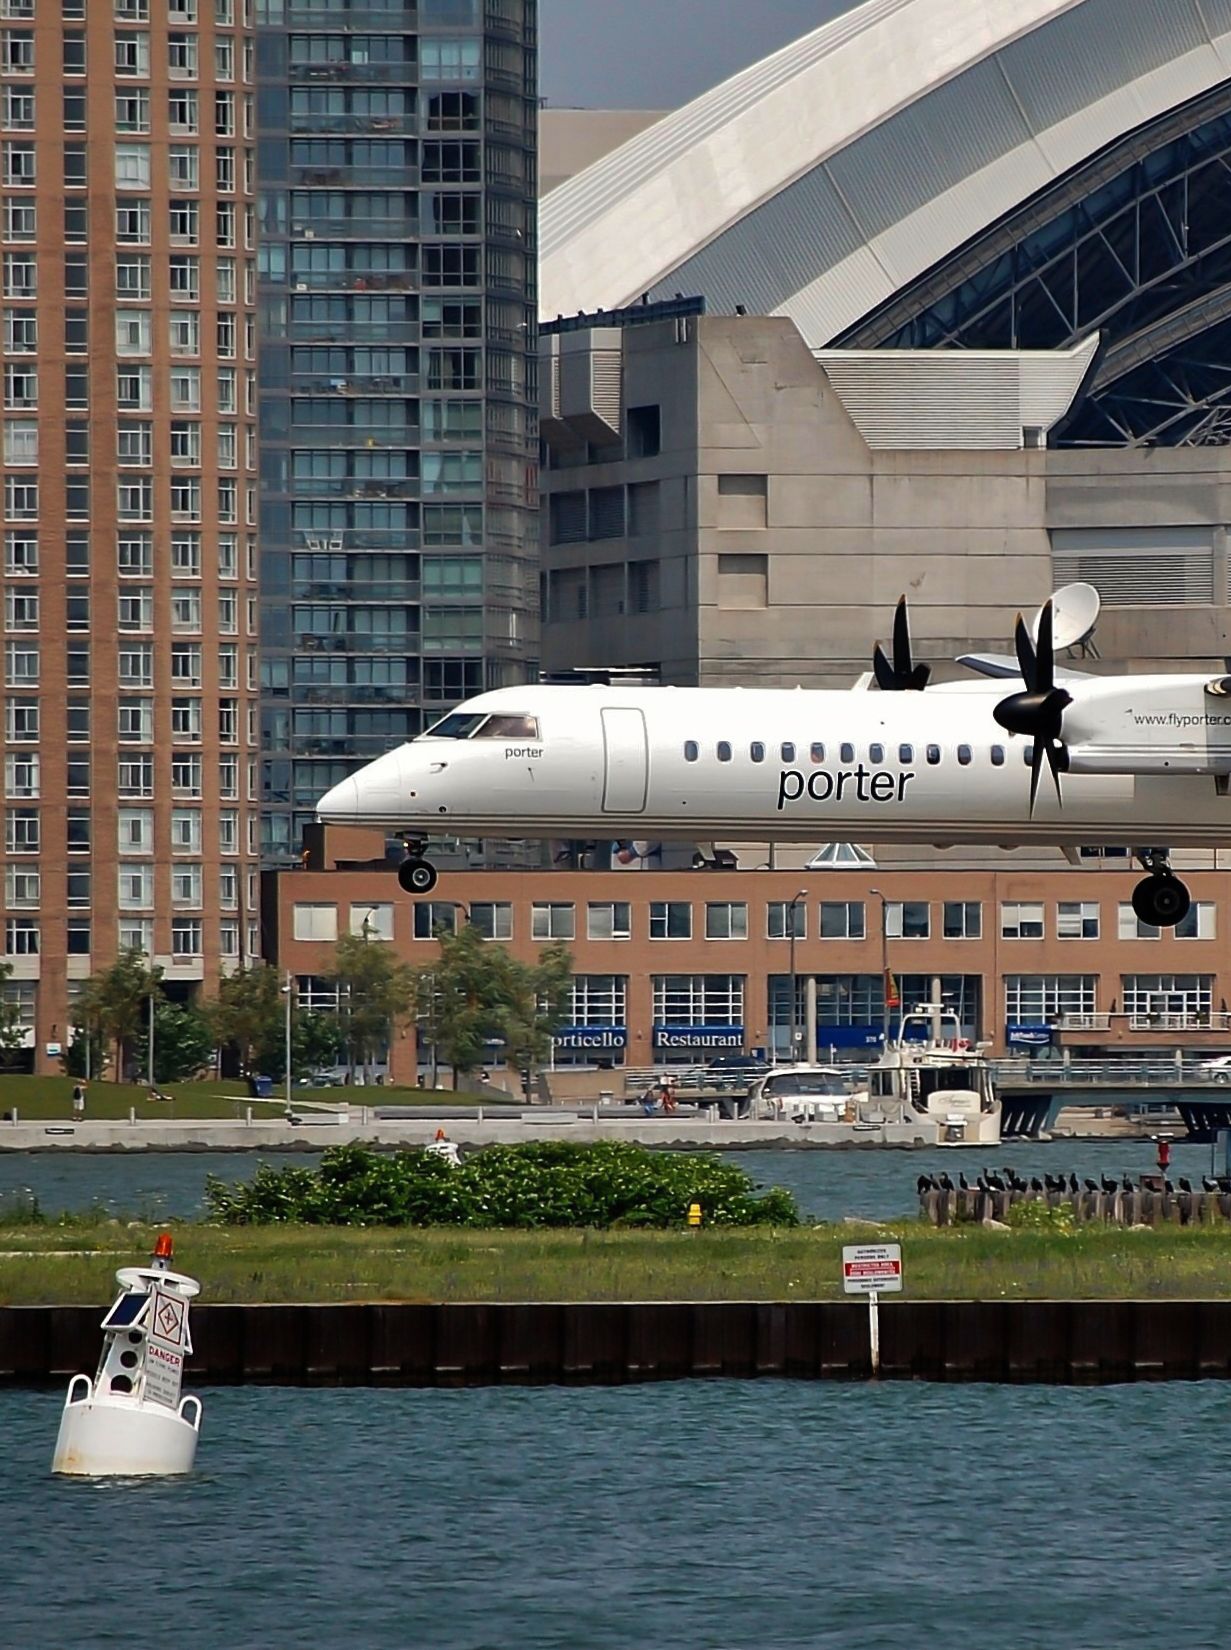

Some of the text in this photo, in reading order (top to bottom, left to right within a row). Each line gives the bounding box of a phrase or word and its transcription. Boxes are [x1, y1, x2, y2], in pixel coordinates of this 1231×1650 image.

[505, 747, 544, 760] porter
[777, 763, 915, 810] porter
[657, 1031, 743, 1047] Restaurant
[149, 1345, 181, 1367] DANGER
